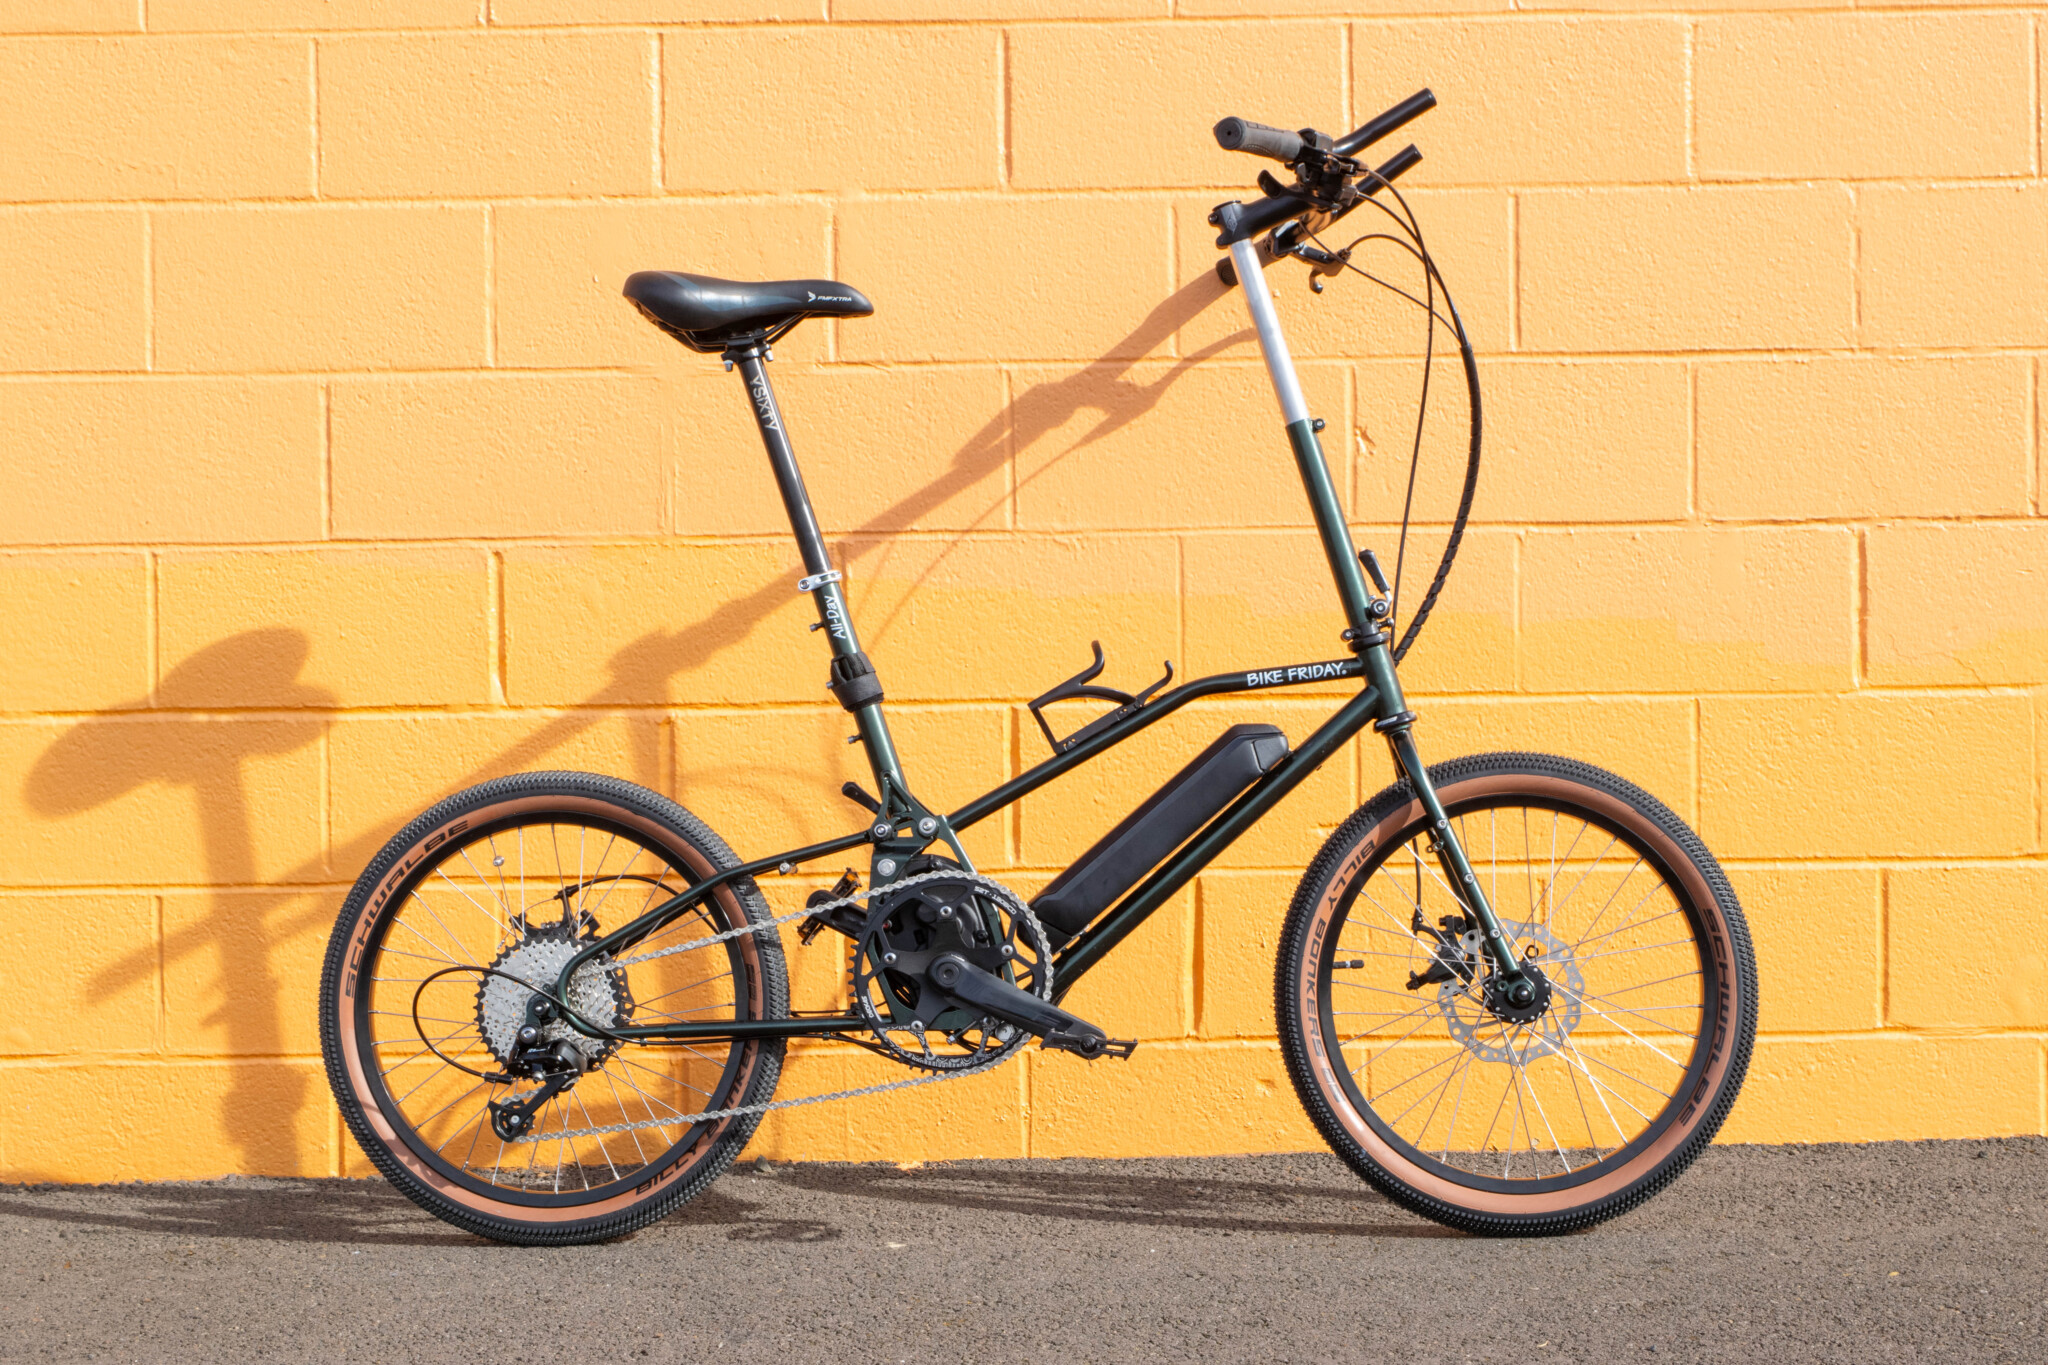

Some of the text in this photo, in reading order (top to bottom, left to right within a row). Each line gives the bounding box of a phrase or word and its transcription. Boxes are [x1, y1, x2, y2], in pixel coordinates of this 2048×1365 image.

[824, 595, 847, 639] All-Day
[1246, 669, 1284, 687] BIKE
[345, 819, 470, 999] SCHWALBE
[1306, 839, 1377, 1058] BILLY BONKERS
[1679, 907, 1730, 1128] SCHWALBE
[635, 1141, 699, 1196] BILLY
